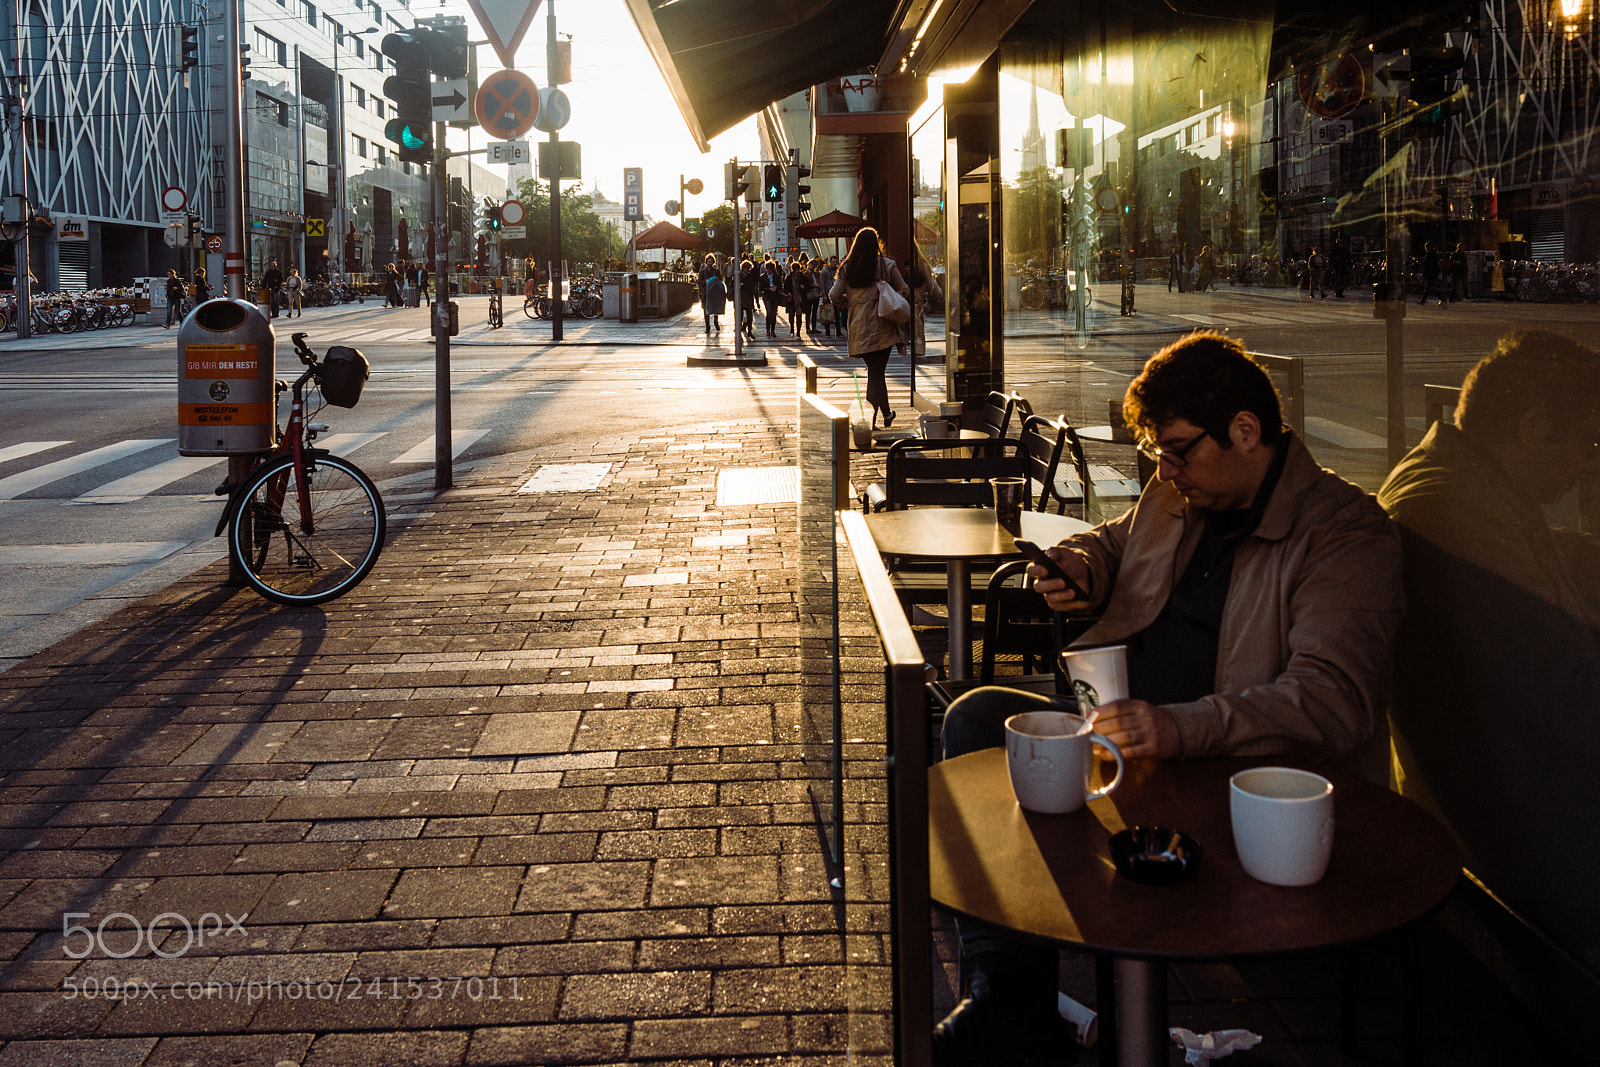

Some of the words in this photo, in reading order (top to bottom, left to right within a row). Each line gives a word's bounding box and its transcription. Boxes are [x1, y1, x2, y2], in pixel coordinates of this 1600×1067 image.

[494, 145, 521, 159] Ende
[626, 174, 636, 186] P
[745, 213, 752, 221] U
[63, 220, 82, 231] dm
[707, 230, 715, 238] U
[816, 226, 856, 235] VAPIANO
[187, 361, 200, 370] GIB
[201, 361, 217, 370] MIR
[218, 361, 234, 370] DEN
[235, 361, 258, 370] REST!
